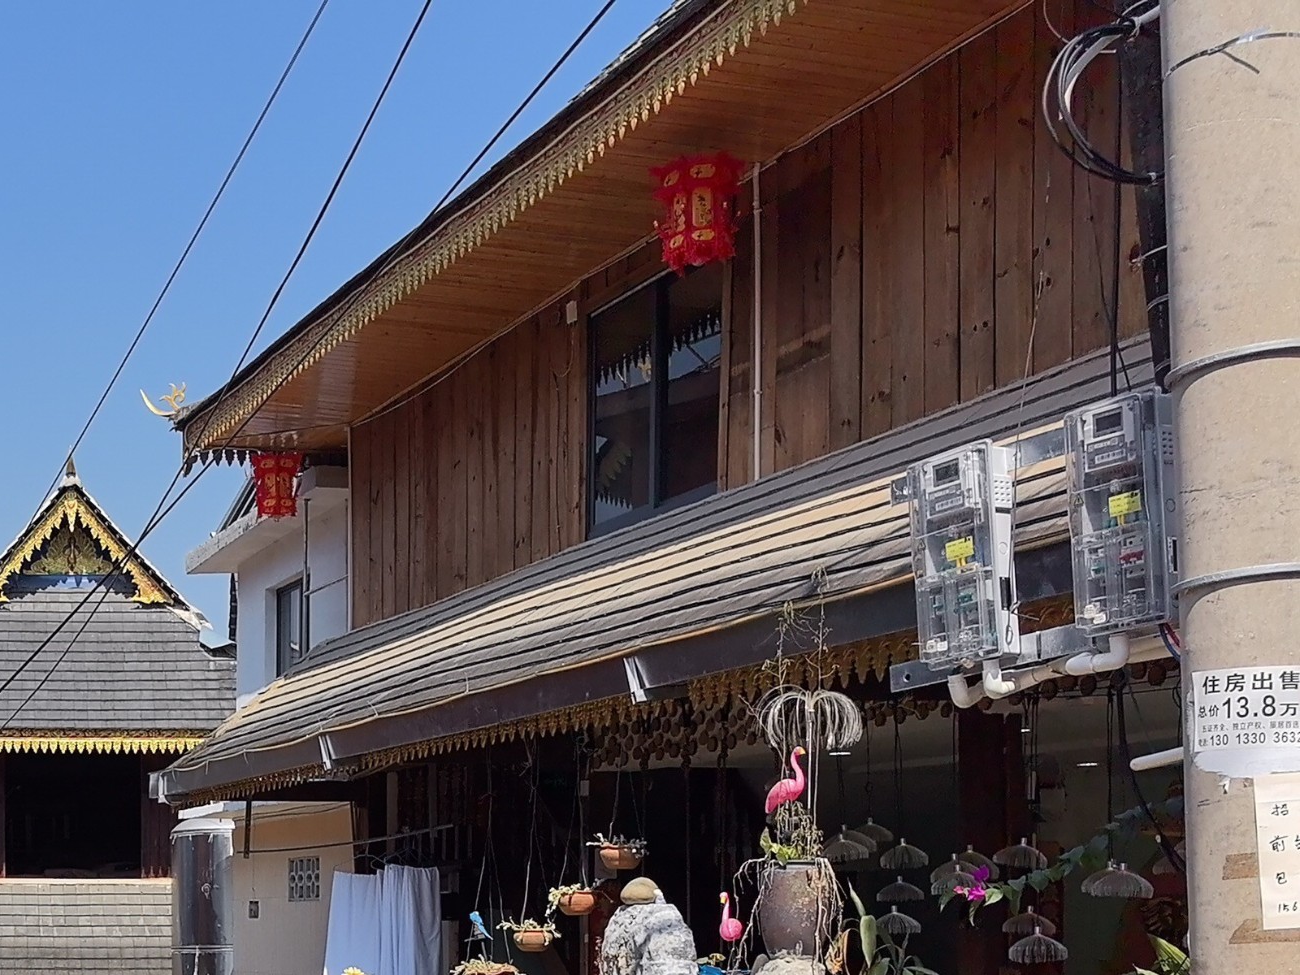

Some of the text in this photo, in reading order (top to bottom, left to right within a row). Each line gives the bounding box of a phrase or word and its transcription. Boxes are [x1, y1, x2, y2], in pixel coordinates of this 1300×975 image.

[1202, 670, 1300, 695] 住房出售
[1236, 732, 1267, 745] 1330
